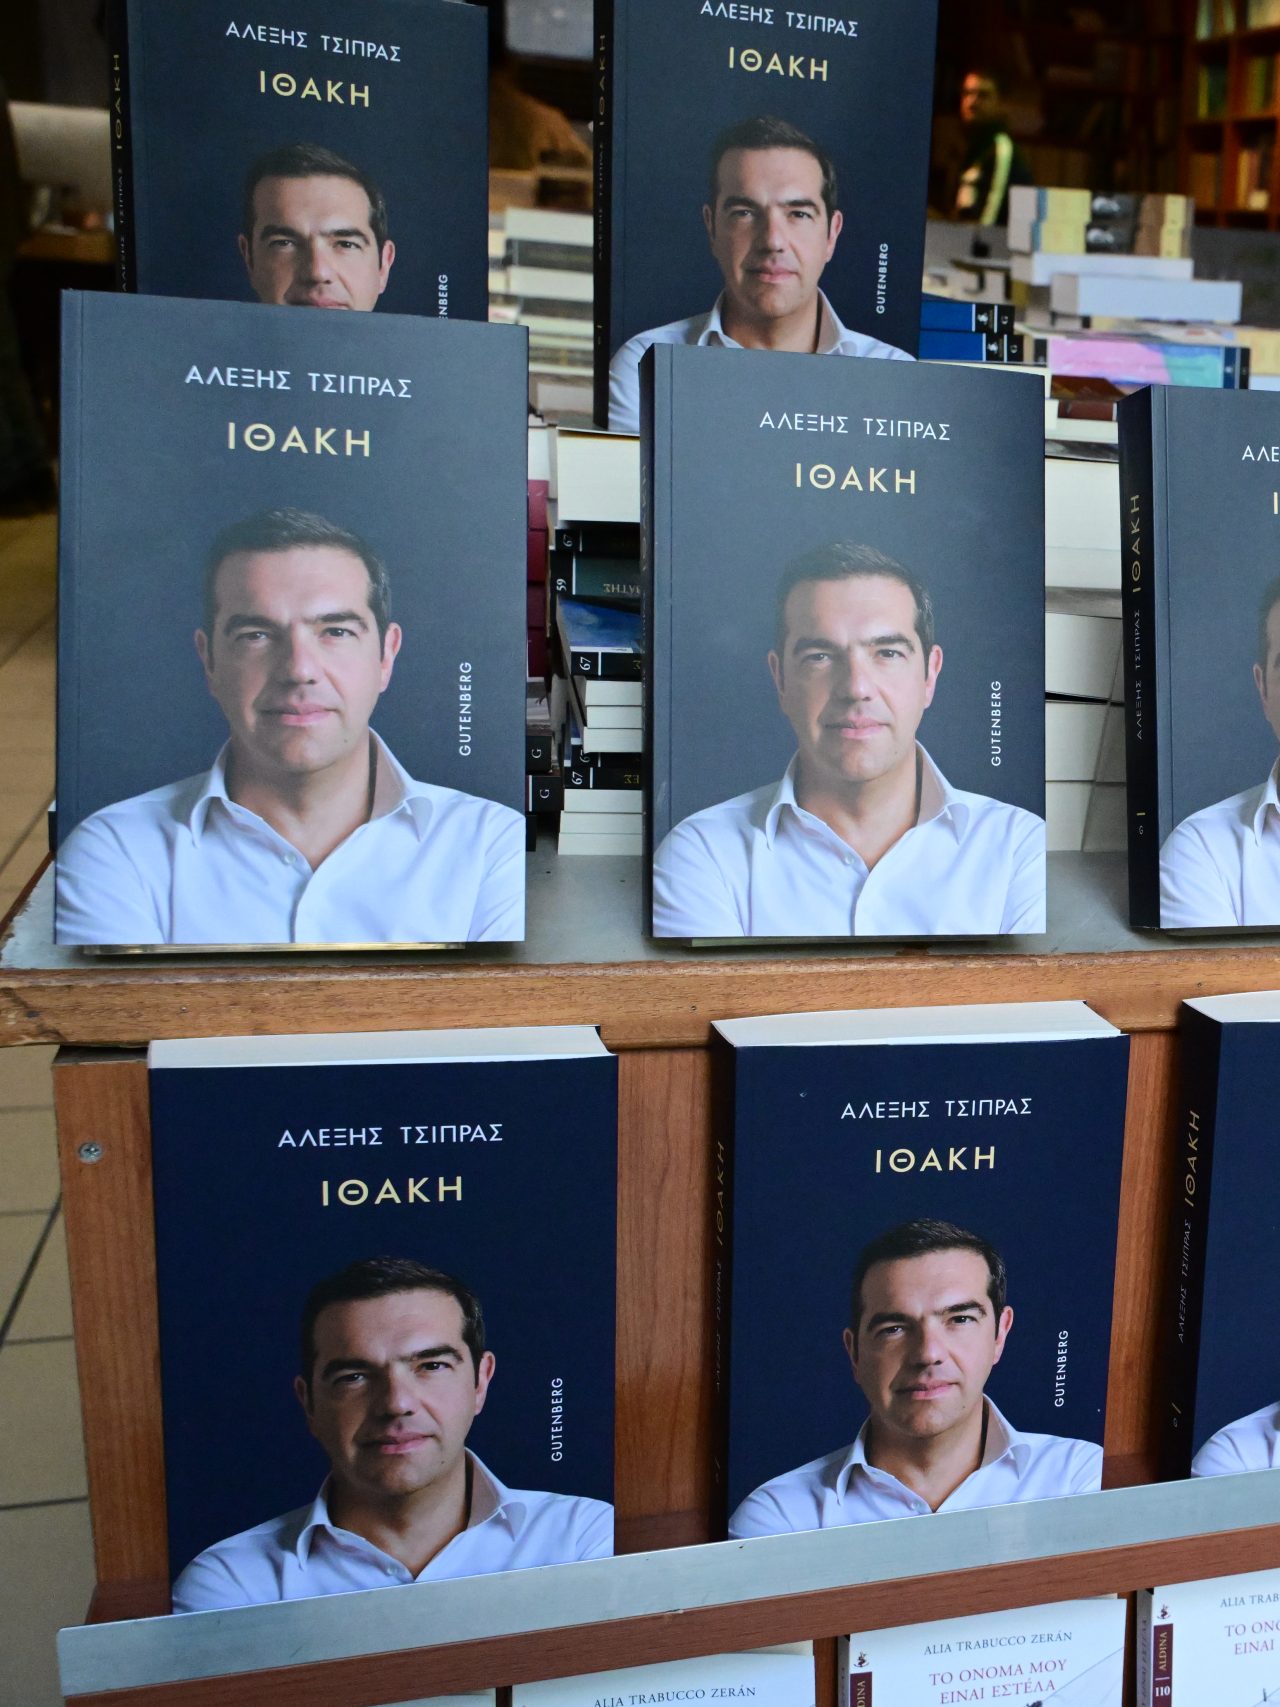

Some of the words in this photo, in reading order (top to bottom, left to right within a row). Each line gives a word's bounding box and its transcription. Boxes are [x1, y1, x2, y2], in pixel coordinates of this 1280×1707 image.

[701, 0, 774, 24] ΑΛΕΞΗΣ
[786, 12, 858, 37] ΤΣΙΠΡΑΣ
[226, 22, 307, 48] ΑΛΕΞΗΣ
[321, 35, 400, 62] ΤΣΙΠΡΑΣ
[729, 47, 827, 81] ΙΘΑΚΗ
[113, 54, 123, 149] ΙΘΑΚΗ
[261, 71, 369, 107] ΙΘΑΚΗ
[876, 244, 888, 314] GUTENBERG
[185, 366, 290, 389] ΑΛΕΞΗΣ
[308, 373, 411, 398] ΤΣΙΠΡΑΣ
[229, 423, 369, 457] ΙΘΑΚΗ
[760, 412, 848, 433] ΑΛΕΞΗΣ
[863, 418, 950, 440] ΤΣΙΠΡΑΣ
[797, 463, 915, 494] ΙΘΑΚΗ
[1131, 494, 1142, 593] ΙΘΑΚΗ
[556, 578, 567, 592] 59
[579, 656, 593, 672] 67
[459, 662, 471, 756] GUTENBERG
[991, 681, 1001, 766] GUTENBERG
[1135, 679, 1143, 741] ΑΛΕΞΗΣ
[531, 747, 543, 760] G
[539, 787, 551, 800] G
[571, 771, 584, 787] 67
[841, 1101, 929, 1119] ΑΛΕΞΗΣ
[945, 1098, 1031, 1116] ΤΣΙΠΡΑΣ
[278, 1128, 382, 1147] ΑΛΕΞΗΣ
[400, 1124, 502, 1143] ΤΣΙΠΡΑΣ
[876, 1146, 994, 1173] ΙΘΑΚΗ
[1184, 1109, 1200, 1207] ΙΘΑΚΗ
[323, 1176, 461, 1206] ΙΘΑΚΗ
[1181, 1218, 1192, 1277] ΤΣΙΠΡΑΣ
[1177, 1286, 1188, 1344] ΑΛΕΞΗΣ
[1055, 1331, 1068, 1407] GUTENBERG
[551, 1378, 562, 1461] GUTENBERG
[1221, 1597, 1245, 1607] ALIA
[925, 1644, 951, 1654] ALIA
[956, 1636, 1025, 1651] TRABUCCO
[1031, 1630, 1073, 1643] ZERÁN
[1225, 1624, 1246, 1637] ΤΟ
[1158, 1631, 1169, 1672] ALDINA
[1235, 1640, 1274, 1655] ΕΙΝΑΙ
[929, 1673, 953, 1686] ΤΟ
[960, 1664, 1023, 1681] ΟΝΟΜΑ
[1029, 1659, 1067, 1674] ΜΟΥ
[595, 1697, 623, 1707] ALIA
[629, 1690, 705, 1705] TRABUCCO
[711, 1684, 756, 1697] ZERÁN
[941, 1688, 983, 1704] ΕΙΝΑΙ
[1154, 1686, 1171, 1698] 110
